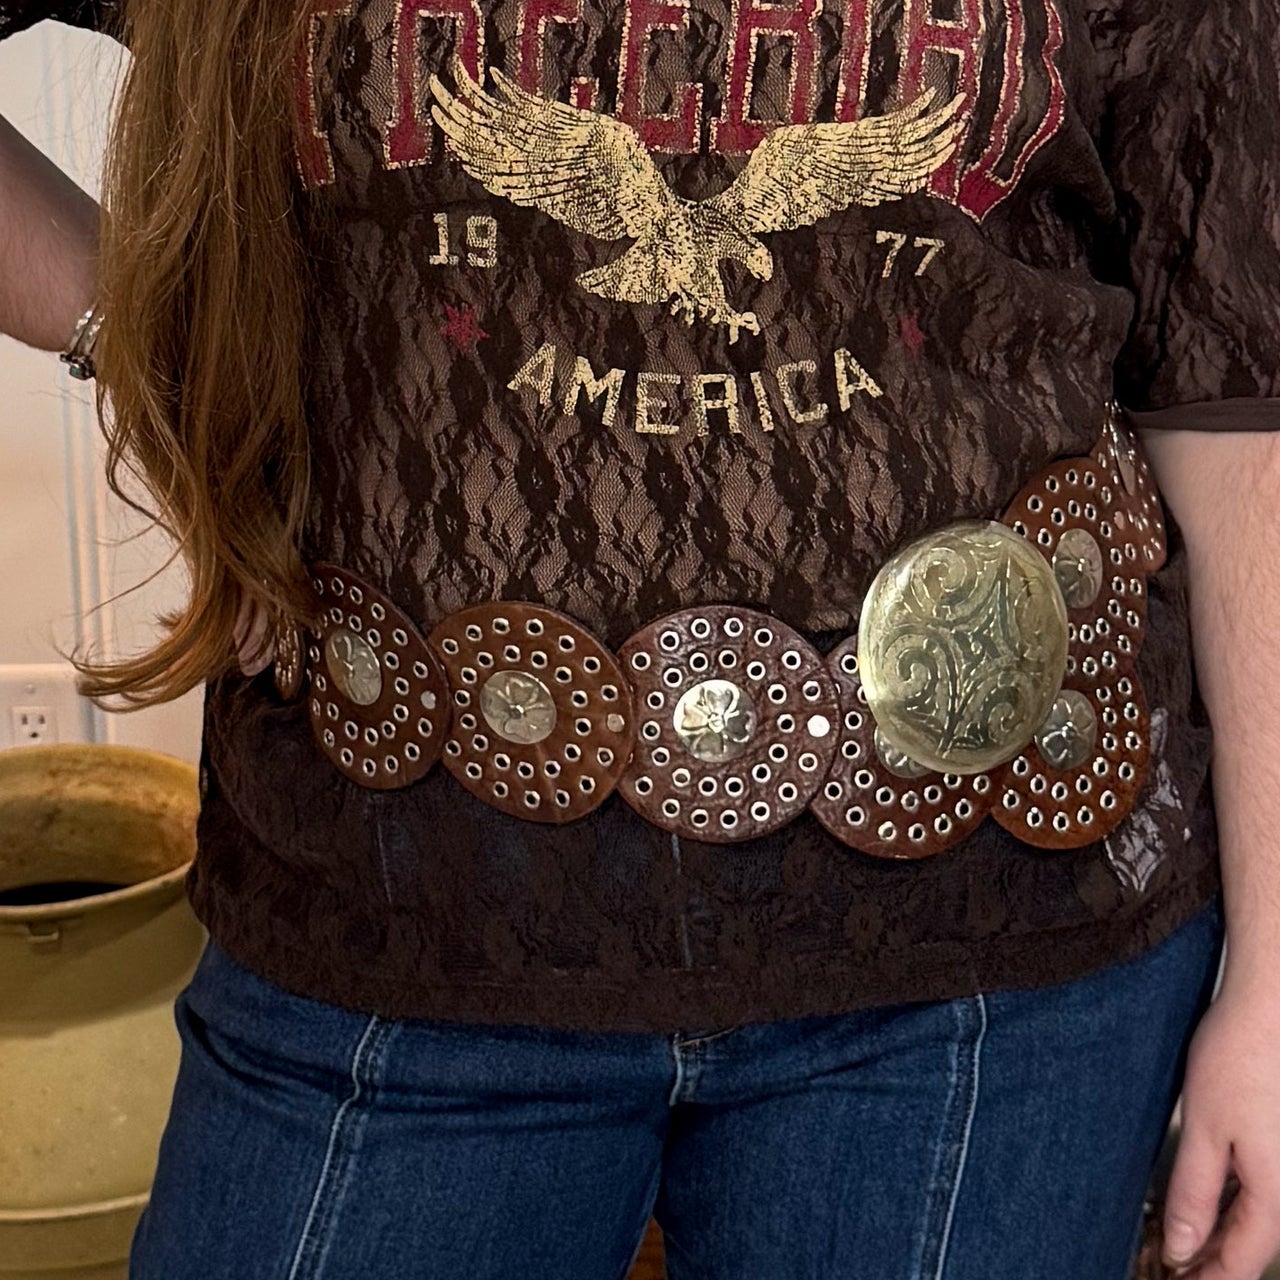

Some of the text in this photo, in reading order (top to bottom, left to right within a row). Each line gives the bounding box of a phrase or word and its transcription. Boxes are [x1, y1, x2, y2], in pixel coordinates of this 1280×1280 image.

[428, 211, 946, 279] 19 77
[506, 342, 885, 438] AMERICA
